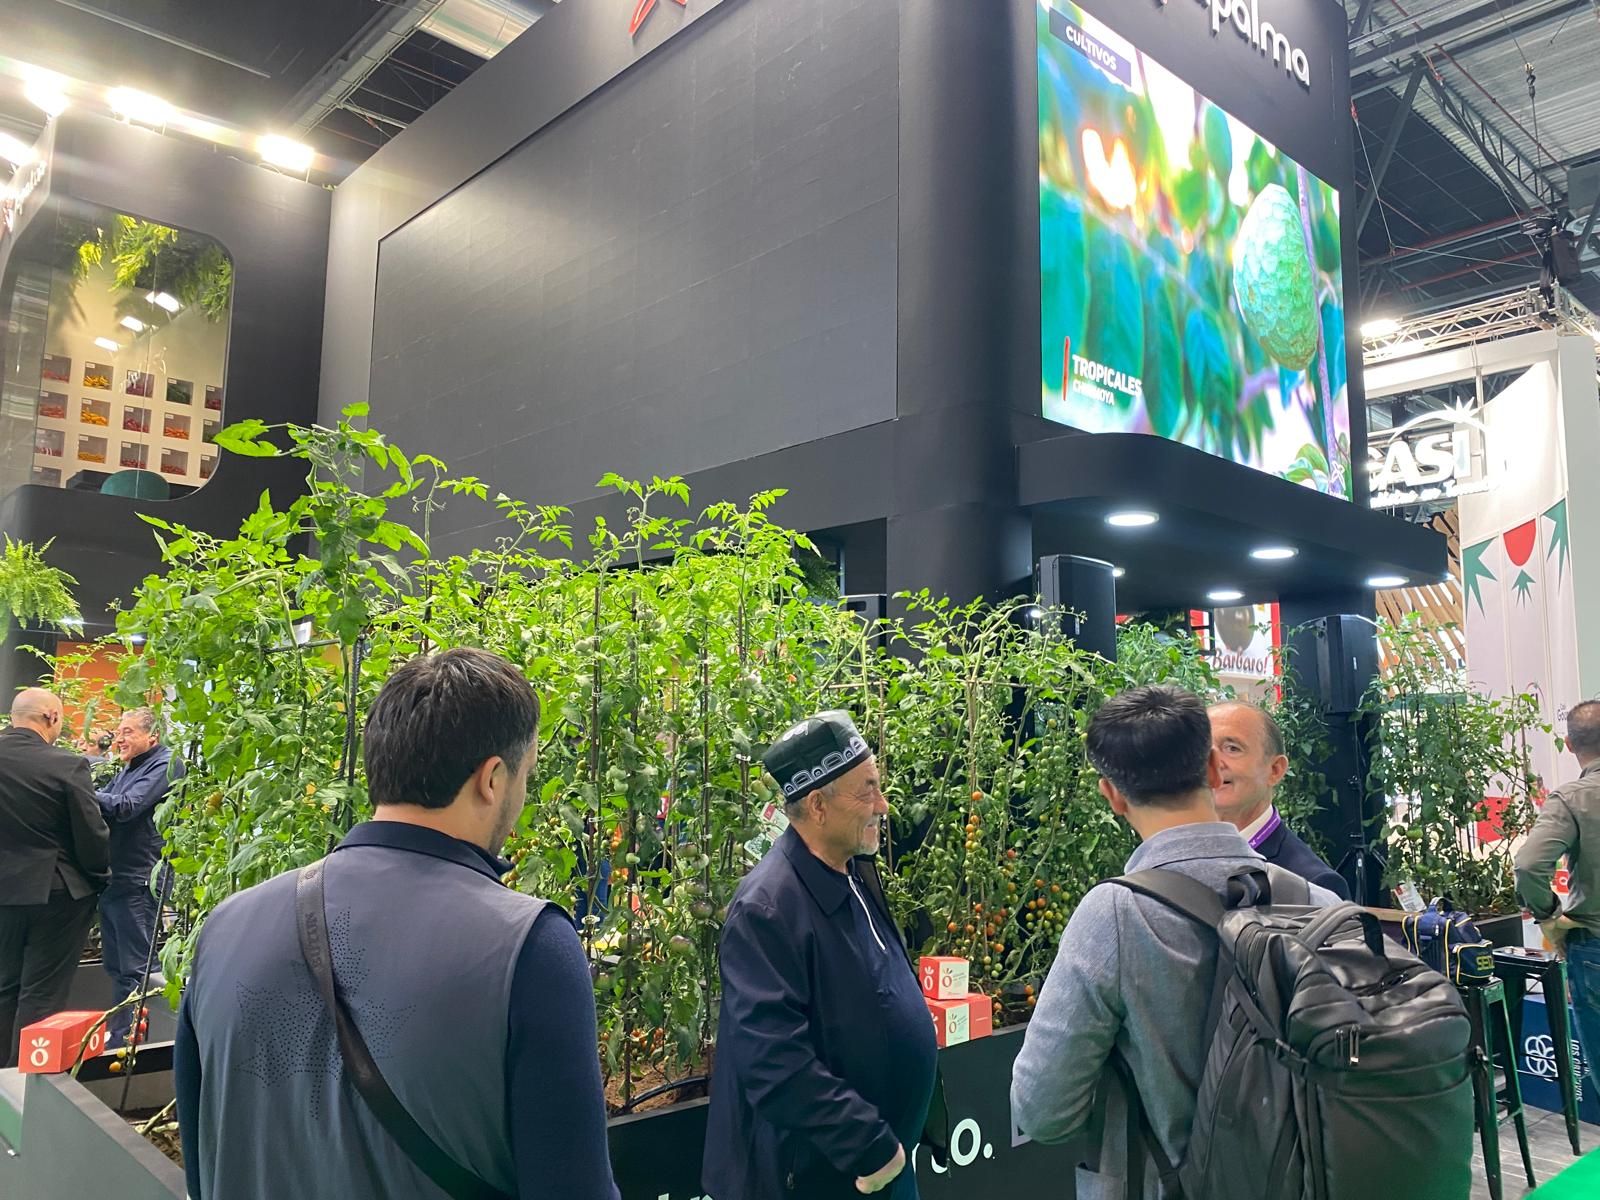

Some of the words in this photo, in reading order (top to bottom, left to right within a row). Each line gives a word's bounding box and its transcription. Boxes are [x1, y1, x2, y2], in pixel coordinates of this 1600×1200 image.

[1065, 25, 1117, 71] CULTIVOS
[1204, 0, 1310, 86] palma
[1072, 353, 1143, 397] TROPICALES
[1072, 379, 1115, 406] CHMOYA
